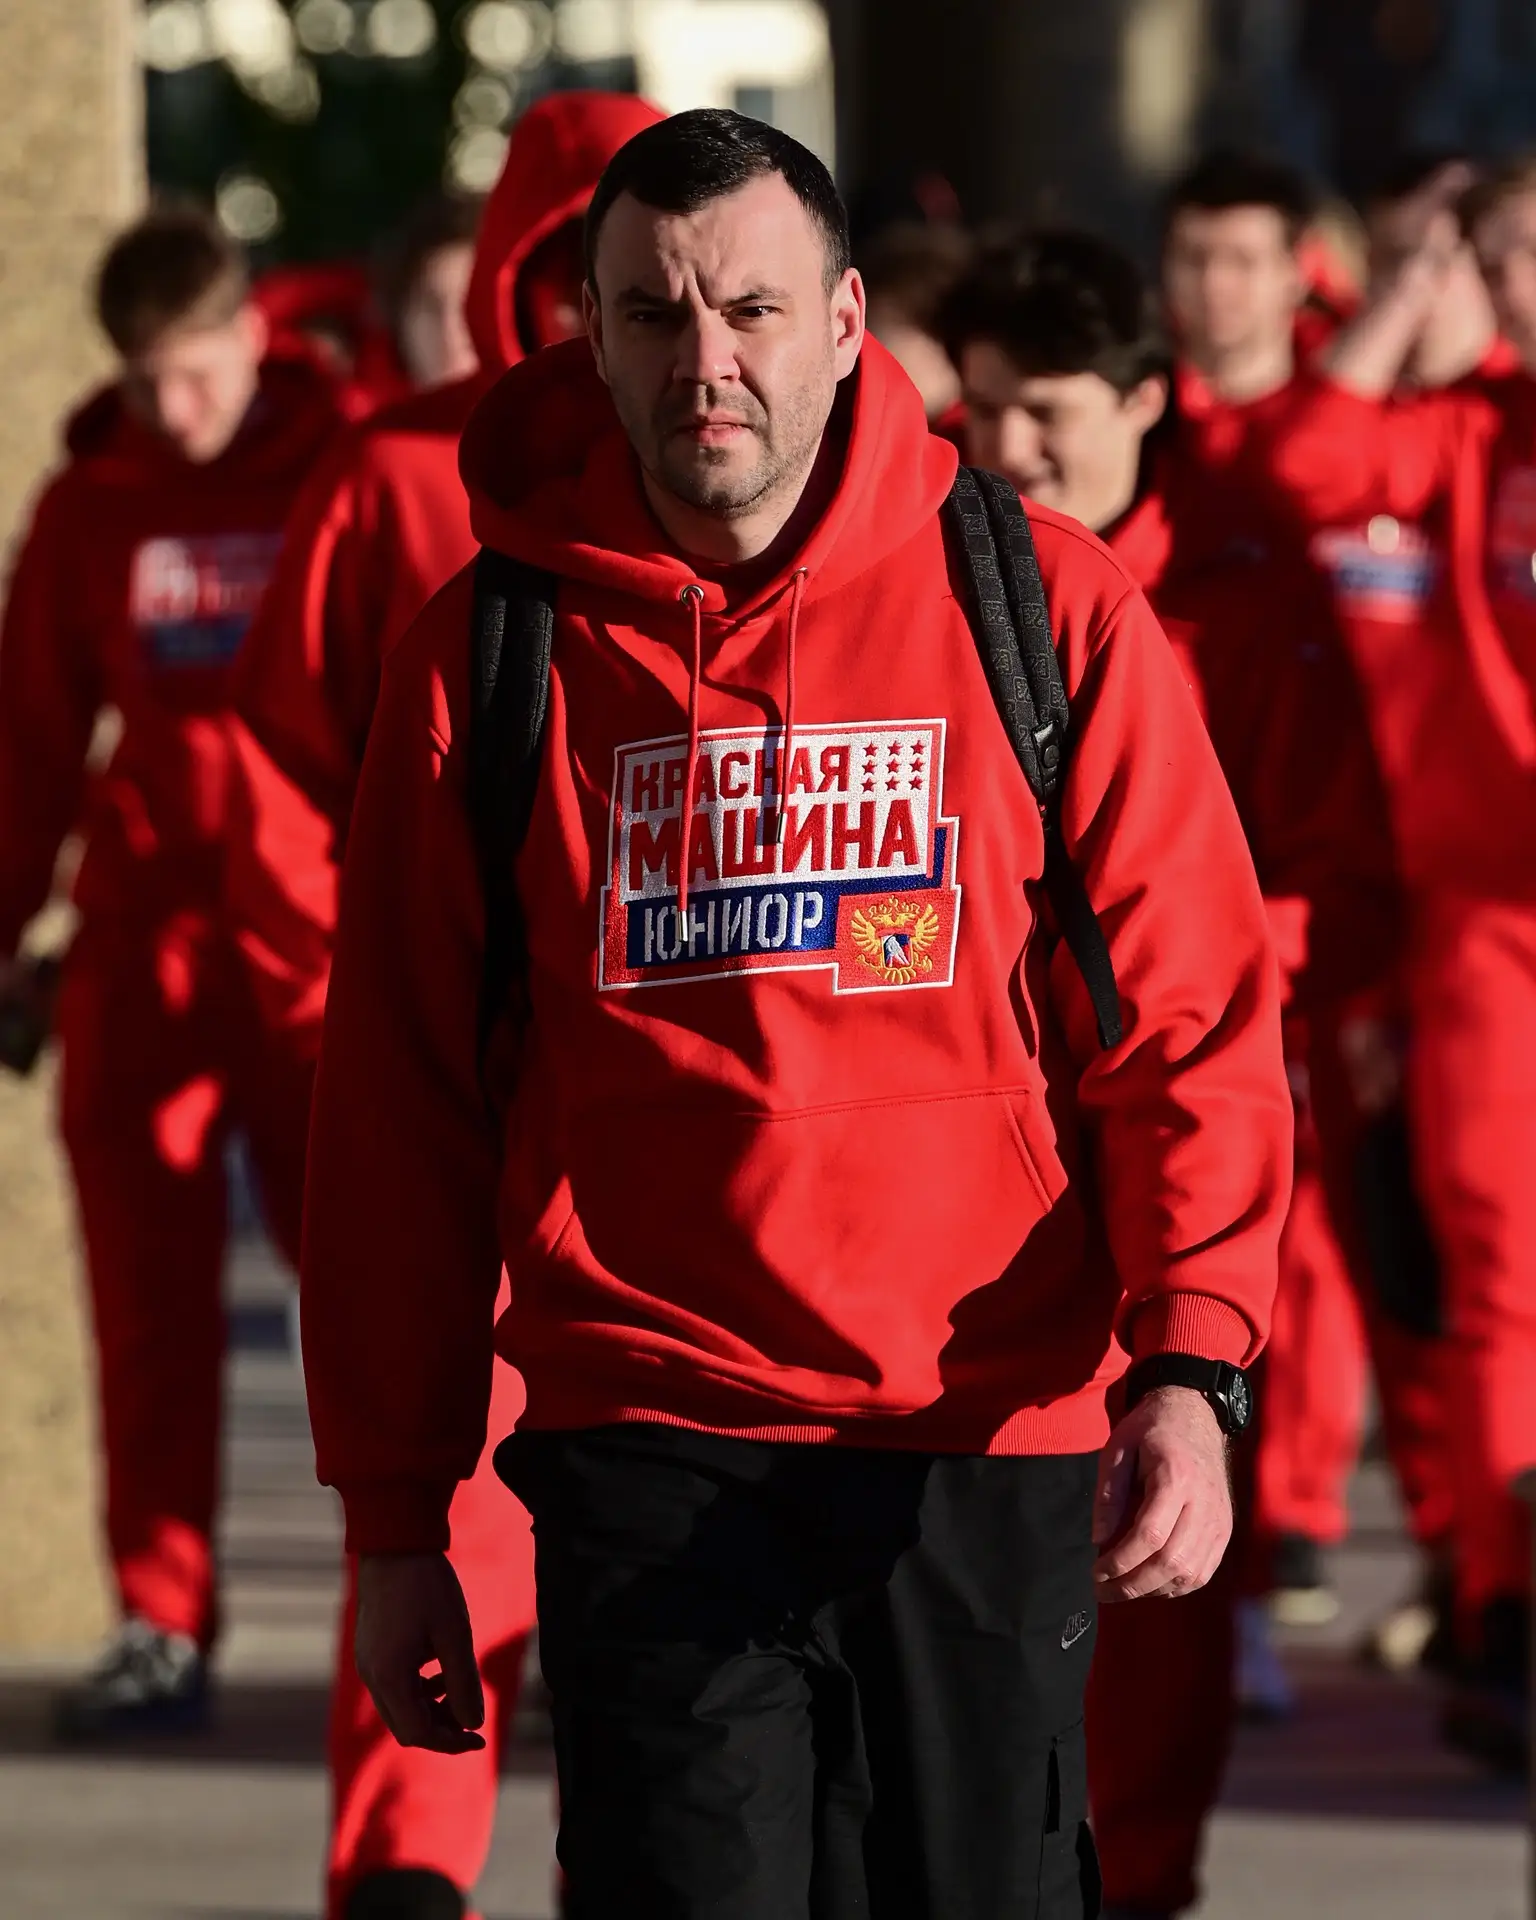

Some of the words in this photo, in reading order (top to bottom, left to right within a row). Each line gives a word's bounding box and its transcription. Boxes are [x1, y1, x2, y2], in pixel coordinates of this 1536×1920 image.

[633, 745, 849, 812] КРАСНАЯ
[629, 800, 919, 891] МАШИНА
[644, 891, 824, 962] ЮНИОР
